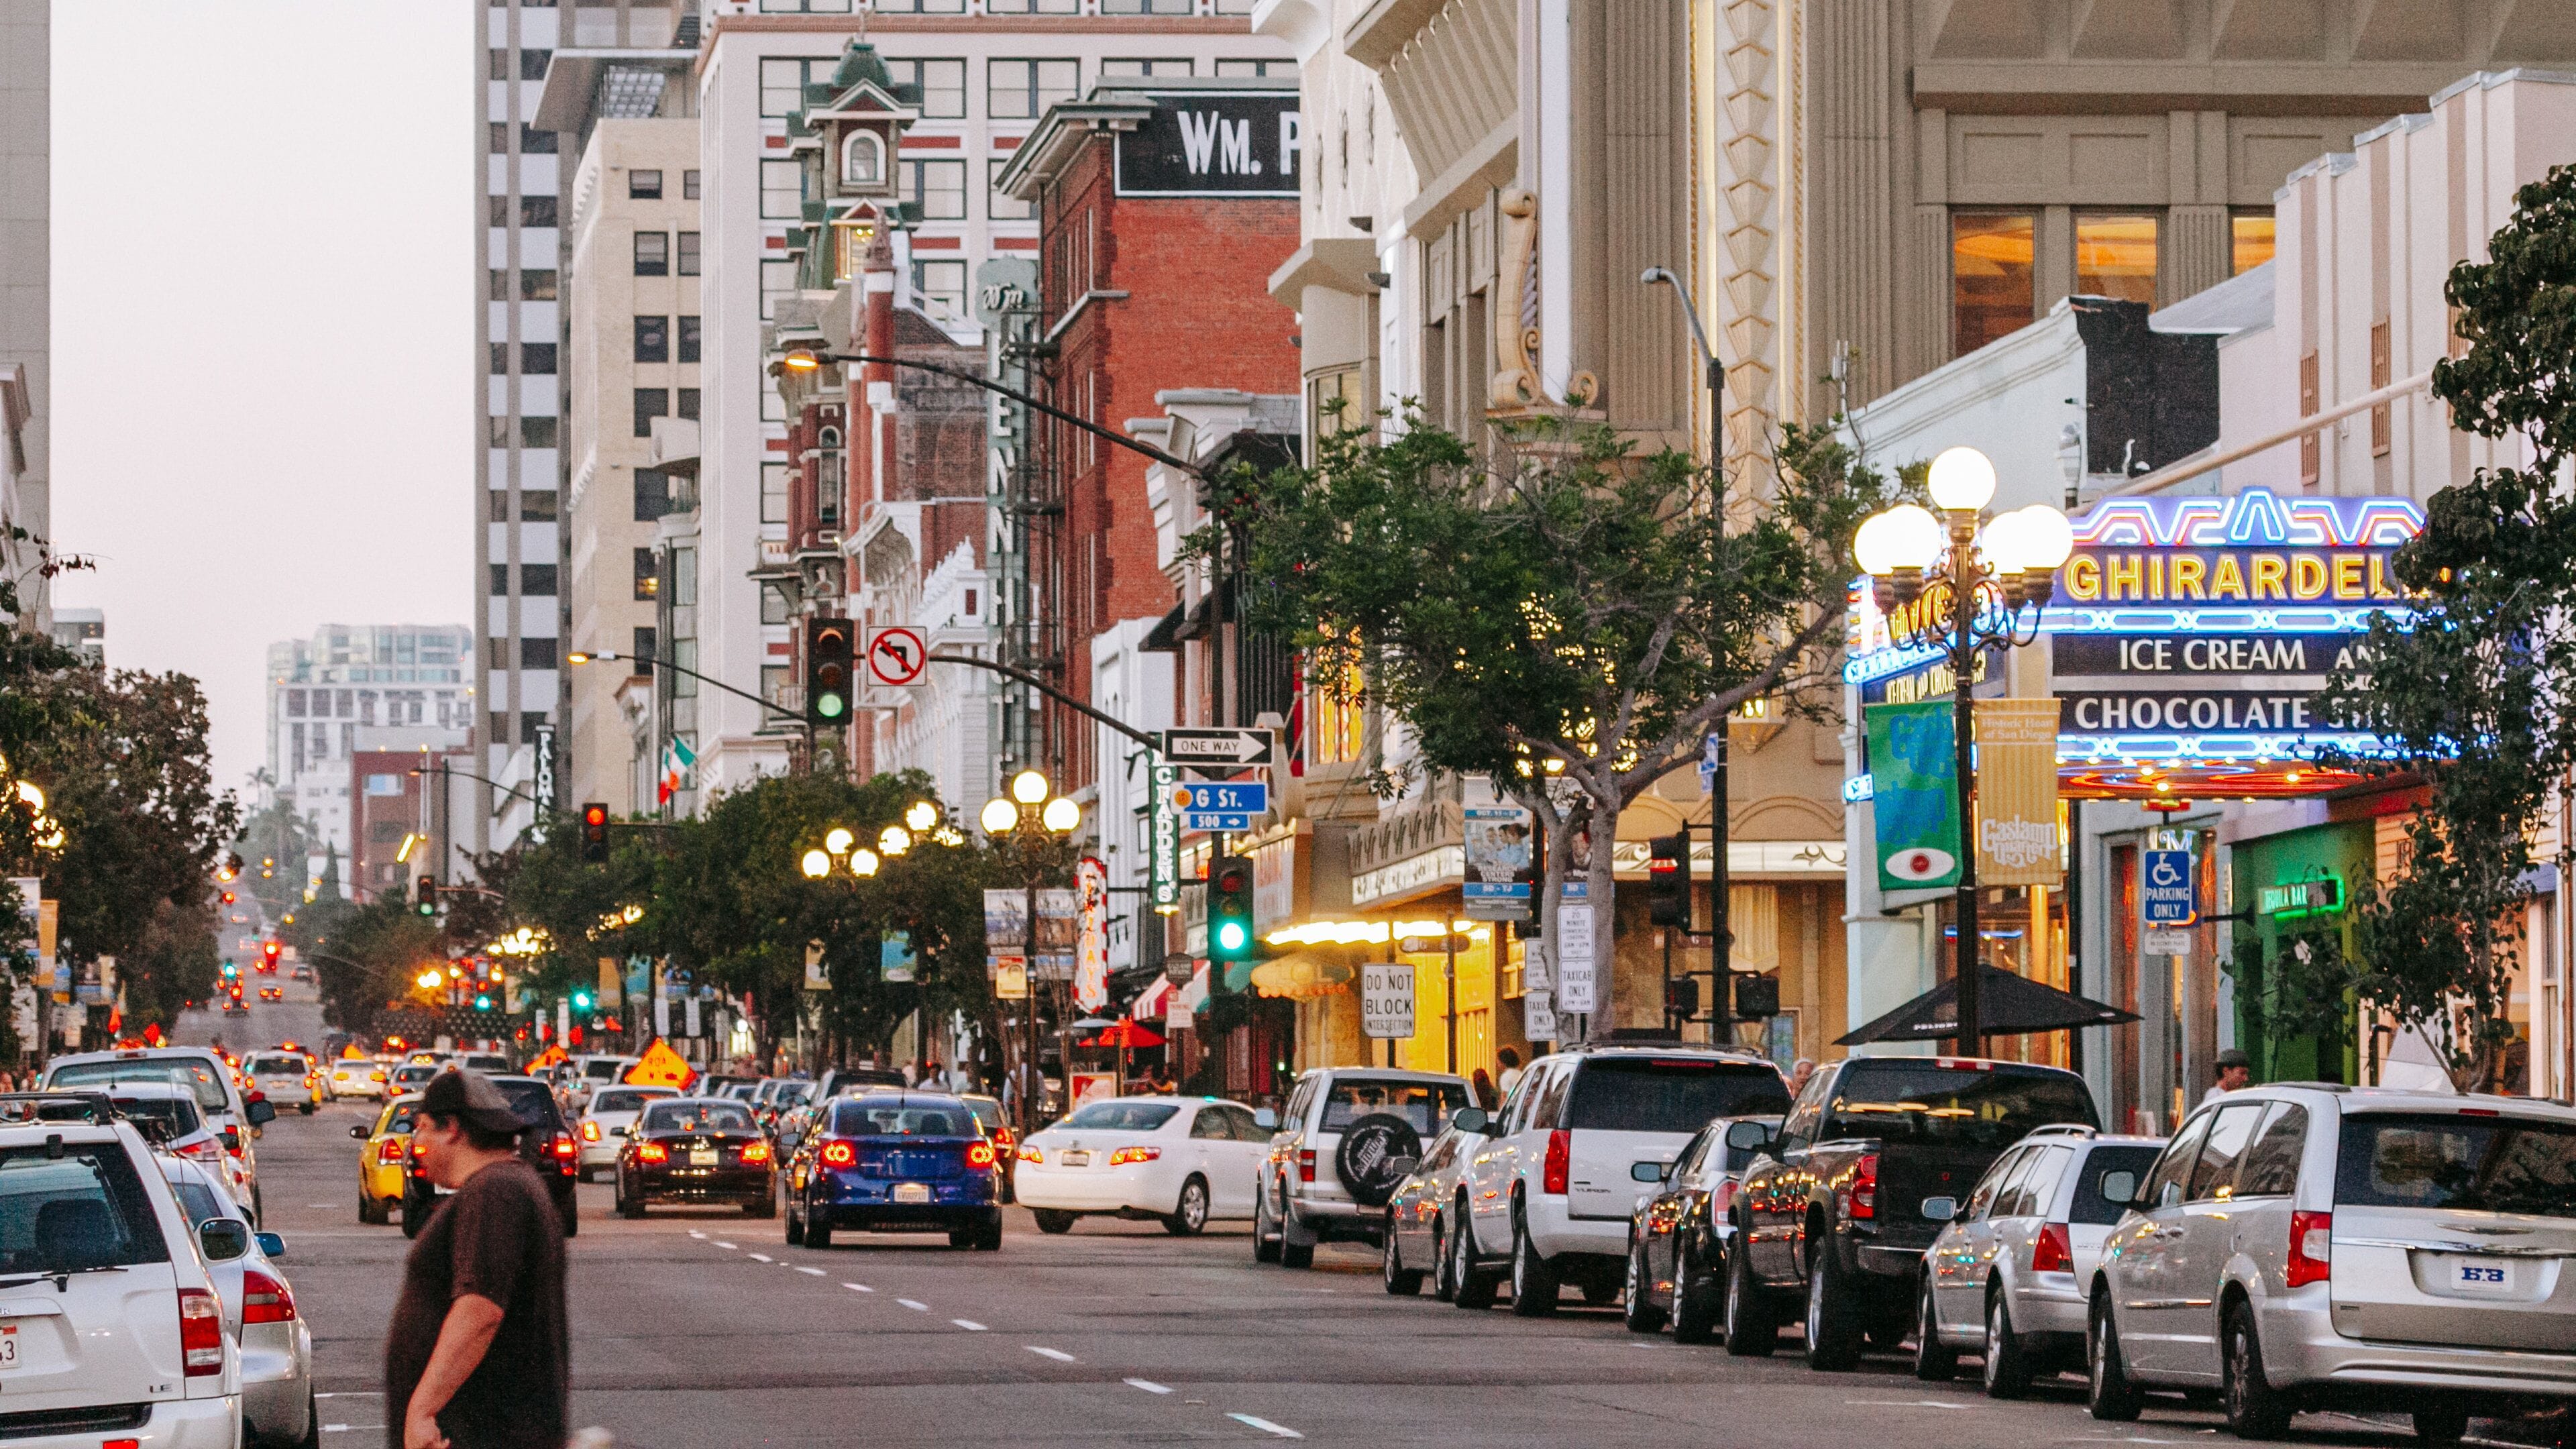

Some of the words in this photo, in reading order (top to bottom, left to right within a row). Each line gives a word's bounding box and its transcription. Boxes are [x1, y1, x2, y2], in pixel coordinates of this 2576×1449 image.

[2063, 554, 2401, 601] GHIRARDEL
[2120, 639, 2171, 670] ICE
[2183, 639, 2306, 670] CREAM
[2334, 645, 2381, 669] AN
[2075, 697, 2310, 729] CHOCOLATE
[1181, 740, 1207, 752] ONE
[1213, 740, 1240, 752] WAY
[1196, 789, 1210, 808] G
[1197, 815, 1220, 828] 500
[2146, 887, 2190, 901] PARKING
[2153, 904, 2181, 918] ONLY
[1366, 975, 1381, 991] DO
[1388, 975, 1412, 991] NOT
[1563, 972, 1592, 982] TAXICAB
[1568, 986, 1586, 997] ONLY
[1366, 999, 1412, 1015] BLOCK
[1528, 1002, 1548, 1011] TAXIC
[1366, 1020, 1413, 1030] INTERSECTION
[1534, 1016, 1551, 1025] ONLY
[0, 1340, 14, 1362] 3
